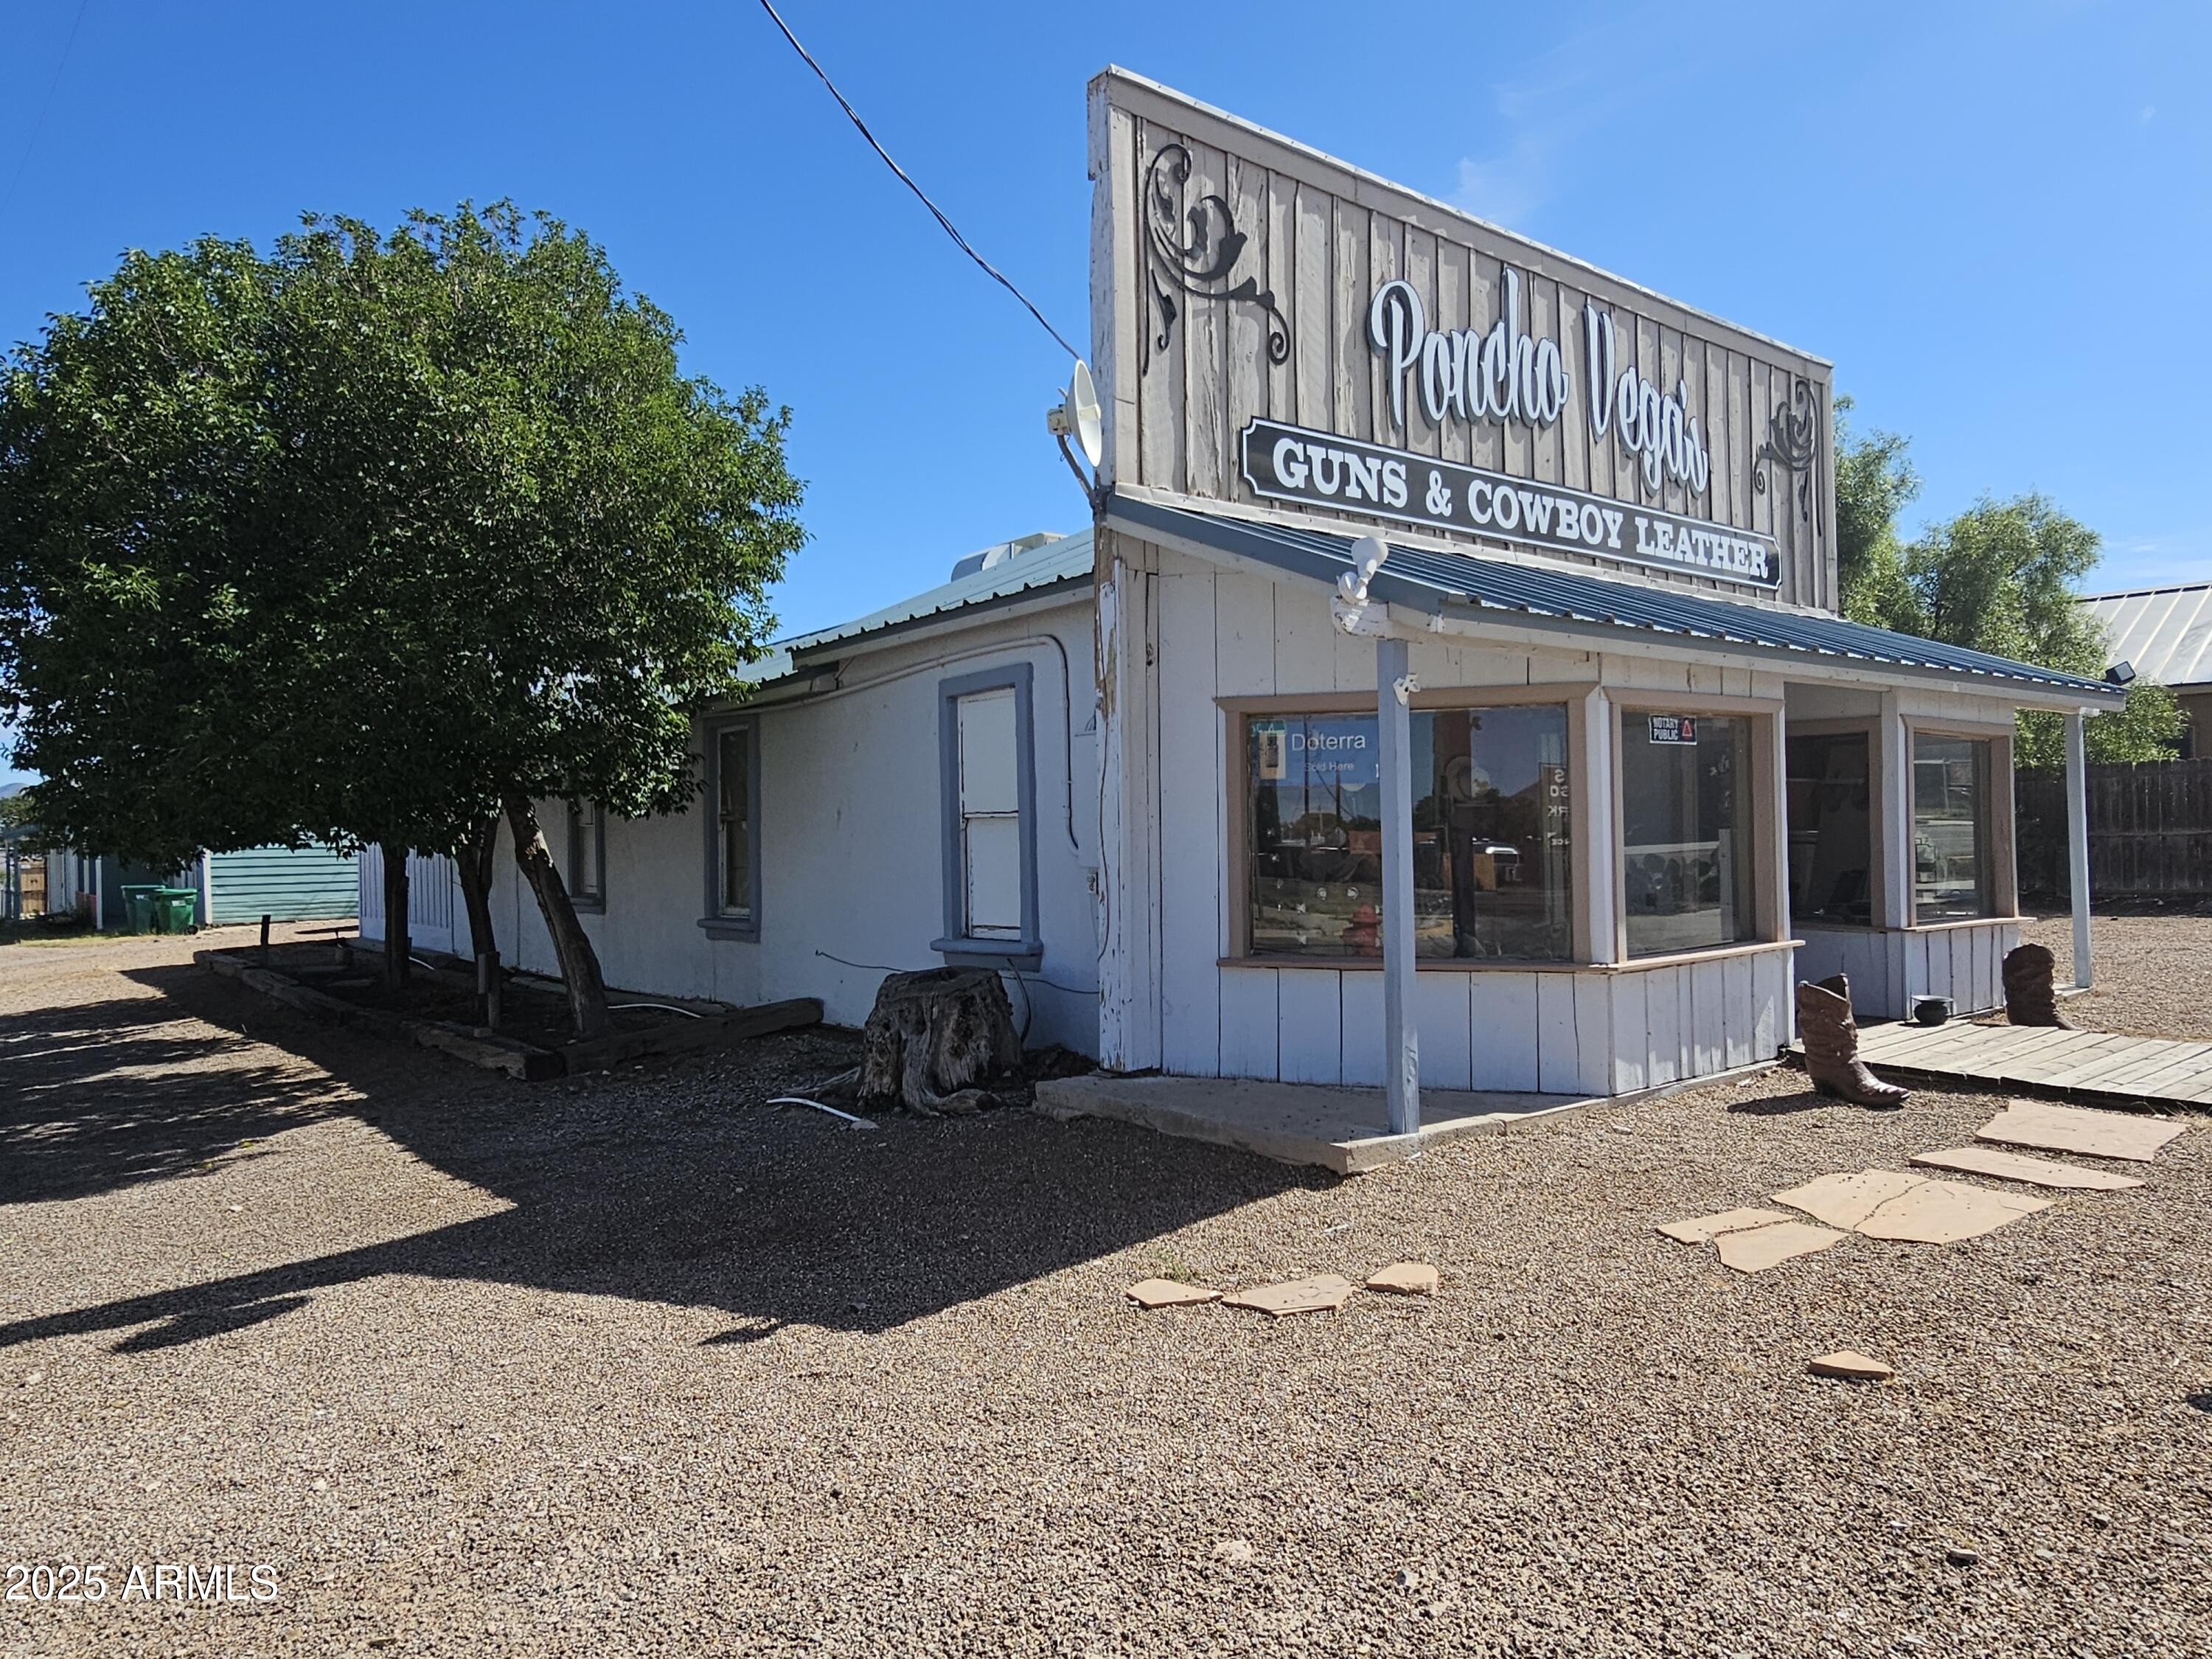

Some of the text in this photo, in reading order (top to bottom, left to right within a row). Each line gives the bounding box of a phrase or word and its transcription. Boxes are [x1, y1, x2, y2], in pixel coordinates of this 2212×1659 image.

[1368, 266, 1570, 426] Poncho
[1272, 437, 1769, 580] GUNS & COWBOY LEATHER
[1652, 716, 1679, 729] NOTARY
[1291, 733, 1366, 751] Doterra
[1653, 728, 1679, 741] PUBLIC
[1329, 762, 1354, 771] Here
